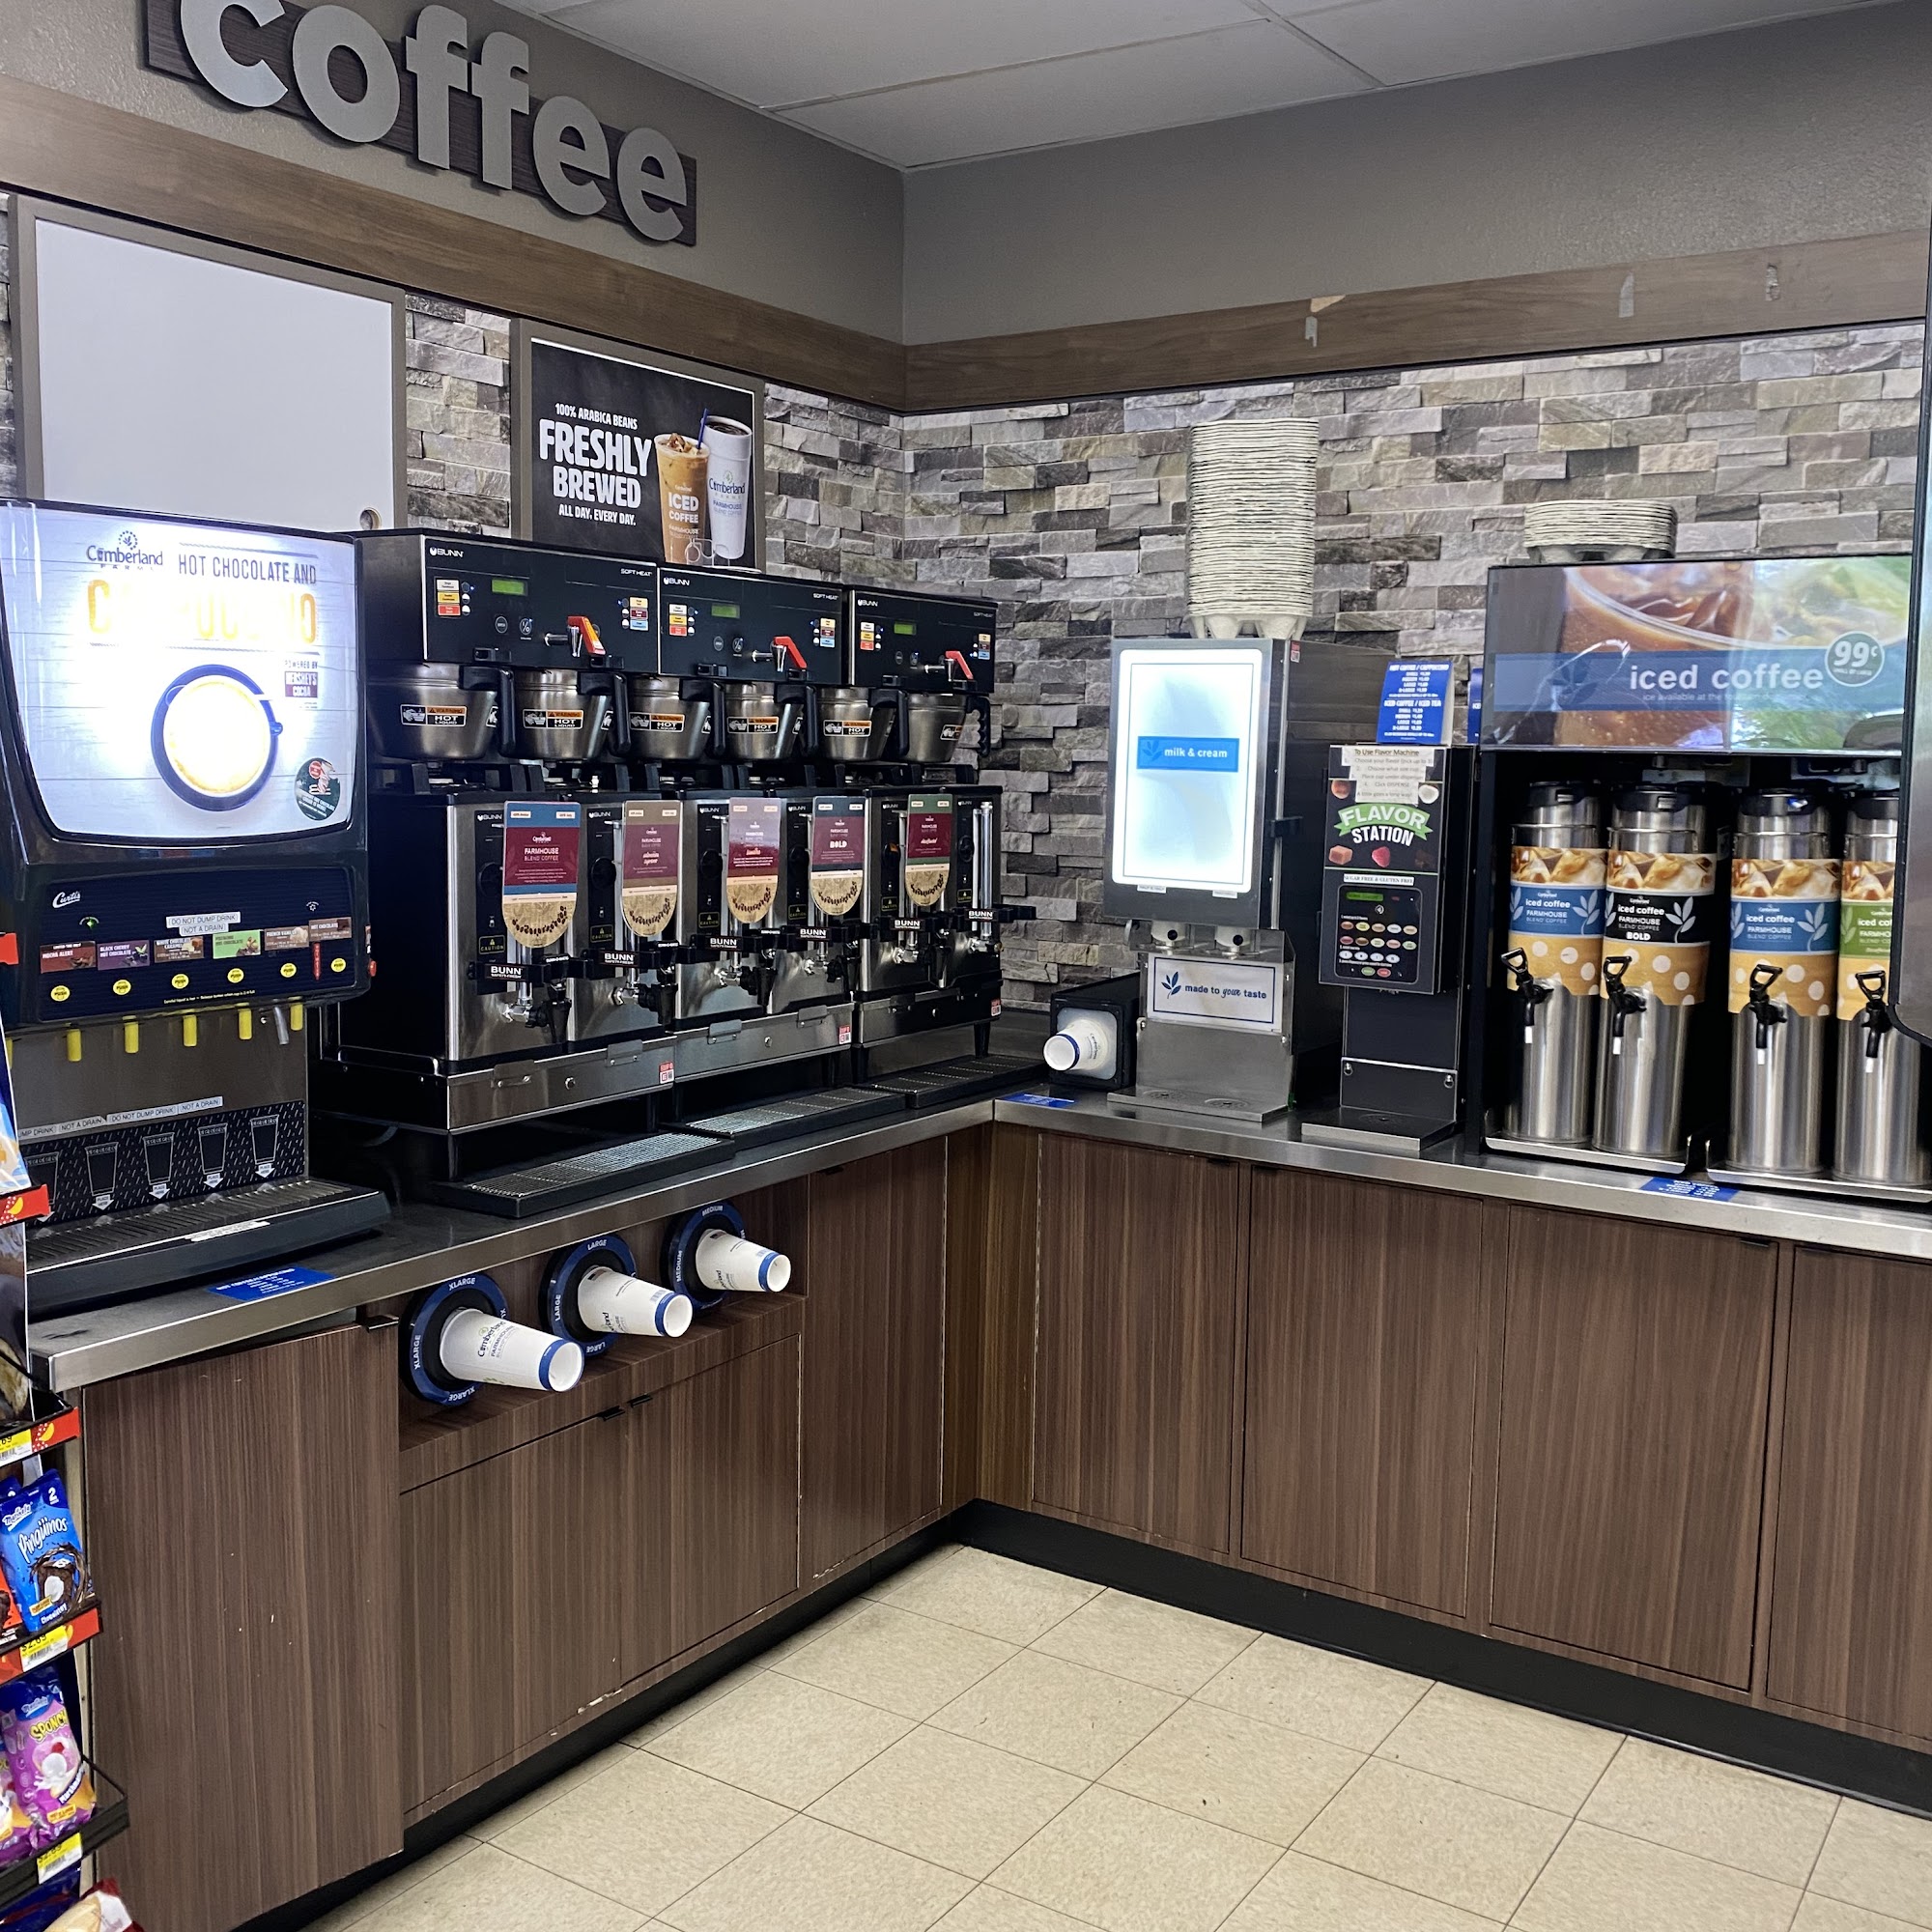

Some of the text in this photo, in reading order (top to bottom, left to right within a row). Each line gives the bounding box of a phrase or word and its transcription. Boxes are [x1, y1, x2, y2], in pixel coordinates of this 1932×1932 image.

[181, 0, 687, 242] coffee
[555, 403, 639, 431] 100% ARABICA BEANS
[539, 418, 653, 477] FRESHLY
[553, 465, 641, 509] BREWED
[668, 492, 699, 513] ICED
[558, 503, 638, 526] ALL DAY, EVERY DAY.
[668, 510, 699, 524] COFFEE
[86, 545, 163, 566] Cumberland
[438, 548, 464, 559] BUNN
[178, 554, 318, 585] HOT CHOCOLATE AND
[668, 578, 691, 586] BUNN
[1630, 663, 1825, 690] iced coffee
[1164, 747, 1228, 758] milk & cream
[1341, 805, 1426, 830] FLAVOR
[1351, 825, 1415, 847] STATION
[830, 840, 848, 849] BOLD
[525, 847, 559, 856] FARMHOUSE
[52, 891, 81, 909] Curtis
[1525, 898, 1571, 908] iced coffee
[968, 910, 992, 919] BUNN
[1526, 910, 1568, 919] FARMHOUSE
[1617, 904, 1664, 916] iced coffee
[196, 915, 215, 923] DUMP
[215, 914, 237, 923] DRINK
[895, 919, 921, 927] BUNN
[1618, 916, 1661, 926] FARMHOUSE
[1746, 914, 1796, 923] iced coffee
[1858, 918, 1877, 926] iced
[183, 925, 197, 934] NOT
[205, 923, 224, 932] DRAIN
[710, 937, 738, 946] BUNN
[1626, 931, 1651, 941] BOLD
[604, 952, 635, 961] BUNN
[491, 966, 523, 975] BUNN
[1185, 984, 1208, 993] made
[1221, 988, 1241, 999] your
[1243, 989, 1267, 999] taste
[136, 1110, 155, 1119] DUMP
[156, 1107, 175, 1116] DRINK
[201, 1098, 219, 1108] DRAIN
[34, 1126, 53, 1135] DRINK
[61, 1122, 74, 1131] NOT
[82, 1118, 102, 1127] DRAIN
[701, 1205, 724, 1217] MEDIUM
[587, 1239, 608, 1251] LARGE
[448, 1277, 476, 1292] XLARGE
[585, 1341, 606, 1353] LARGE
[448, 1385, 475, 1402] XLARGE
[48, 1488, 56, 1501] 2
[17, 1516, 68, 1565] Pingüinos
